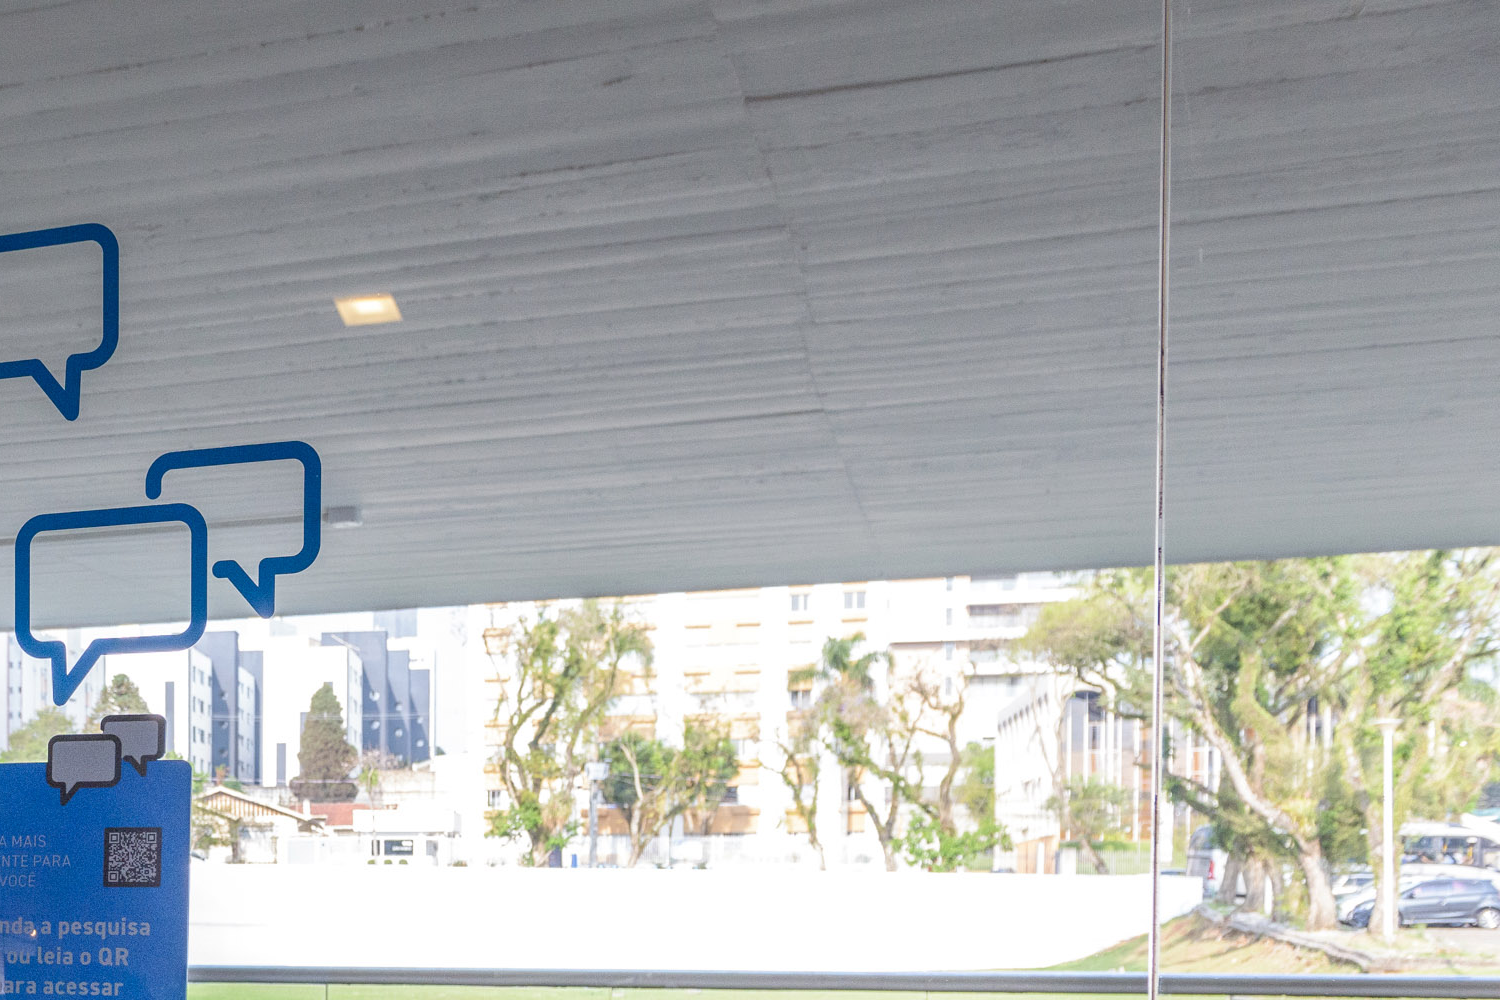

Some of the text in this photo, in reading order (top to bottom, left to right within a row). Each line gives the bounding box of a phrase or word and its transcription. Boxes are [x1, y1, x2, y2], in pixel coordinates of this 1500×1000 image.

[12, 835, 46, 848] MAIS
[34, 855, 71, 867] PARA
[0, 871, 36, 887] VOCÊ
[41, 920, 52, 934] a
[58, 917, 151, 939] pesquisa
[7, 951, 30, 964] ou
[37, 946, 74, 965] leia
[80, 951, 92, 965] o
[98, 948, 129, 966] QR
[43, 980, 124, 996] acessar
